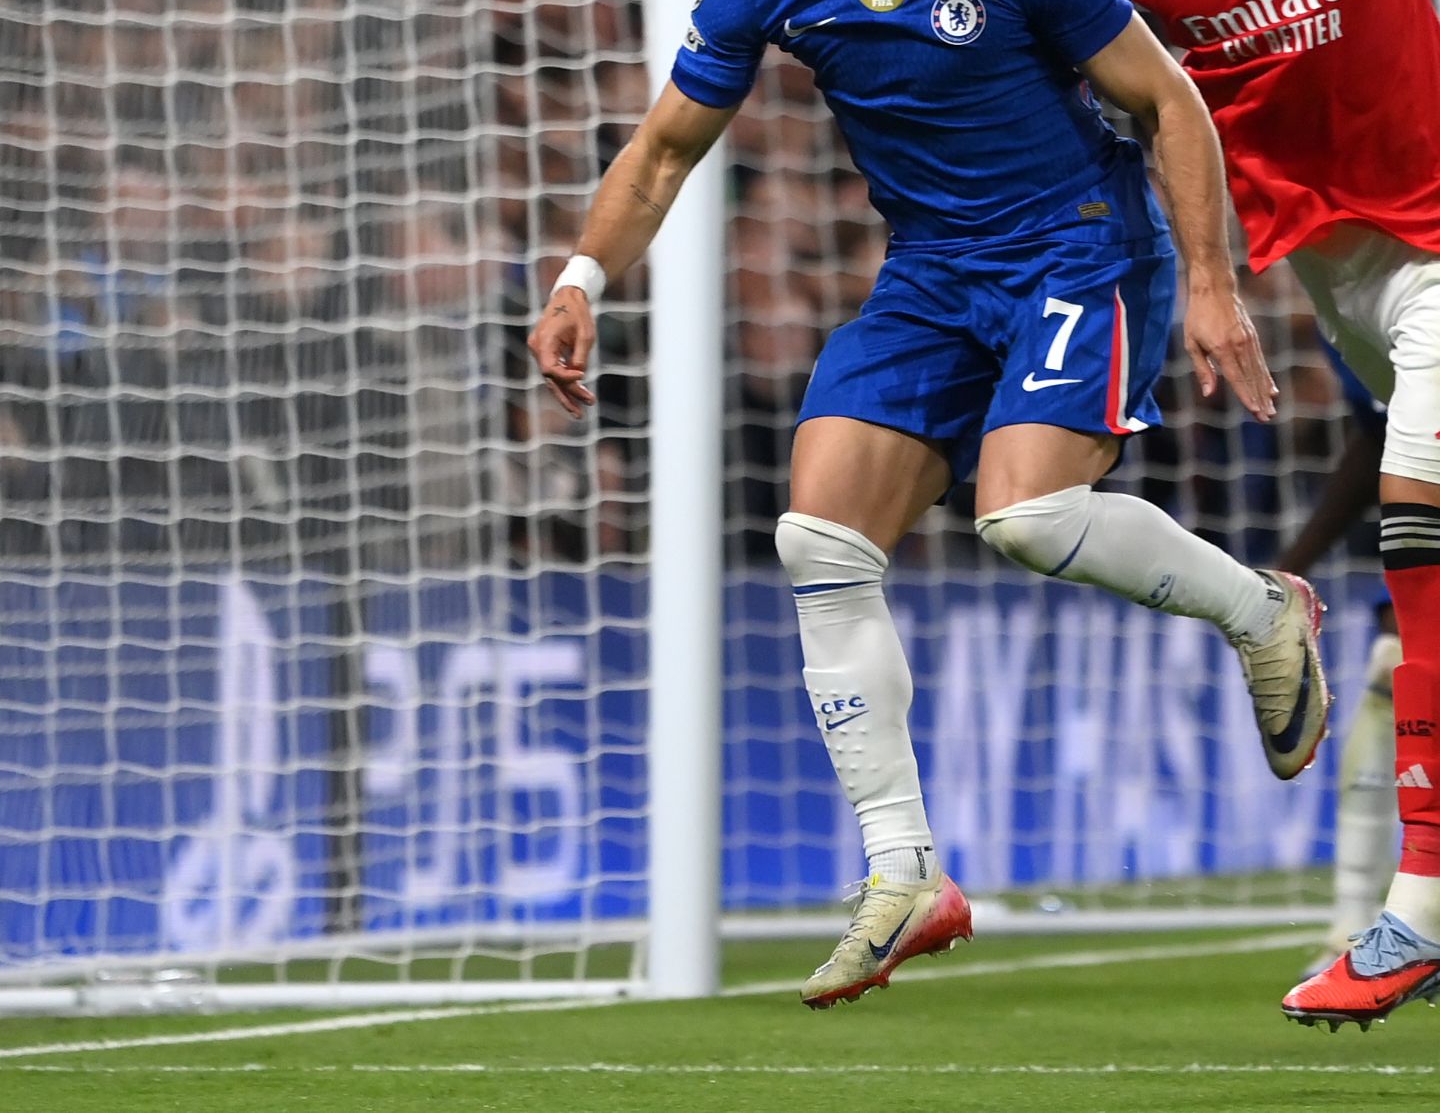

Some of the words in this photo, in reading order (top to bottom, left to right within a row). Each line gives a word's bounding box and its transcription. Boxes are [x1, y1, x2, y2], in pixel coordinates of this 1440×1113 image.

[1221, 35, 1260, 62] FLY
[1262, 8, 1343, 54] BETTER
[1043, 297, 1084, 371] 7
[820, 695, 866, 715] CFC
